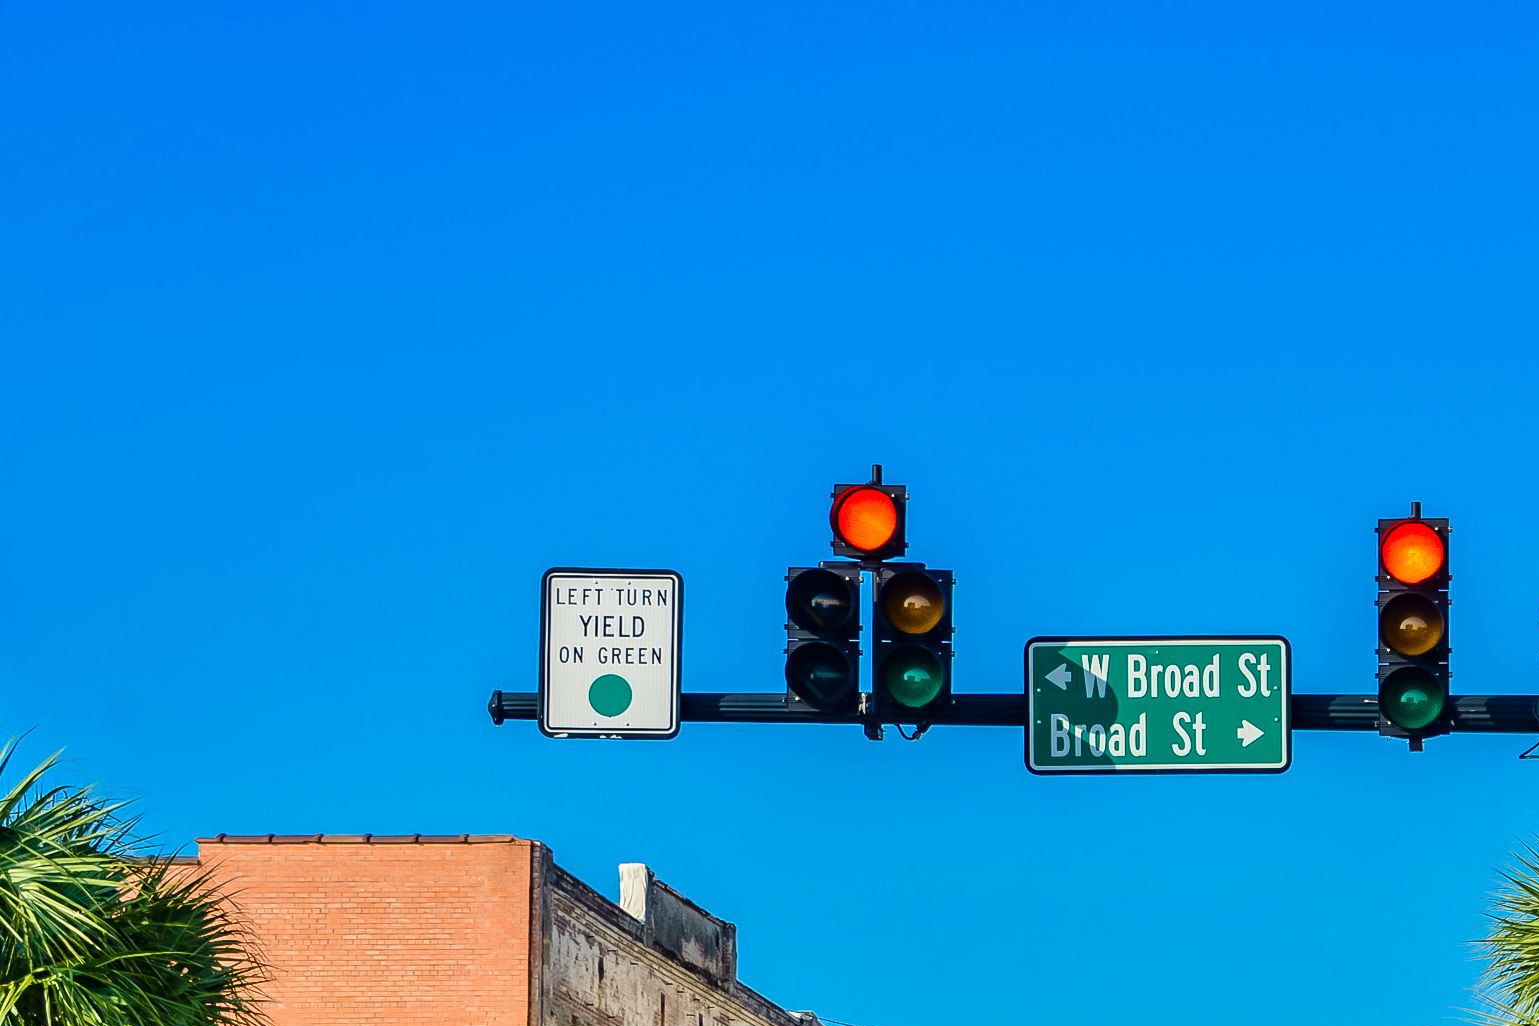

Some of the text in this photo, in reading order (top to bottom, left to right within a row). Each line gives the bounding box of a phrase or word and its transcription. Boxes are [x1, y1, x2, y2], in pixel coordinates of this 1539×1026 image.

[556, 588, 669, 606] LEFT TURN
[579, 614, 645, 638] YIELD
[559, 646, 662, 665] ON GREEN
[1081, 652, 1271, 699] W Broad St
[1050, 711, 1207, 757] Broad St
